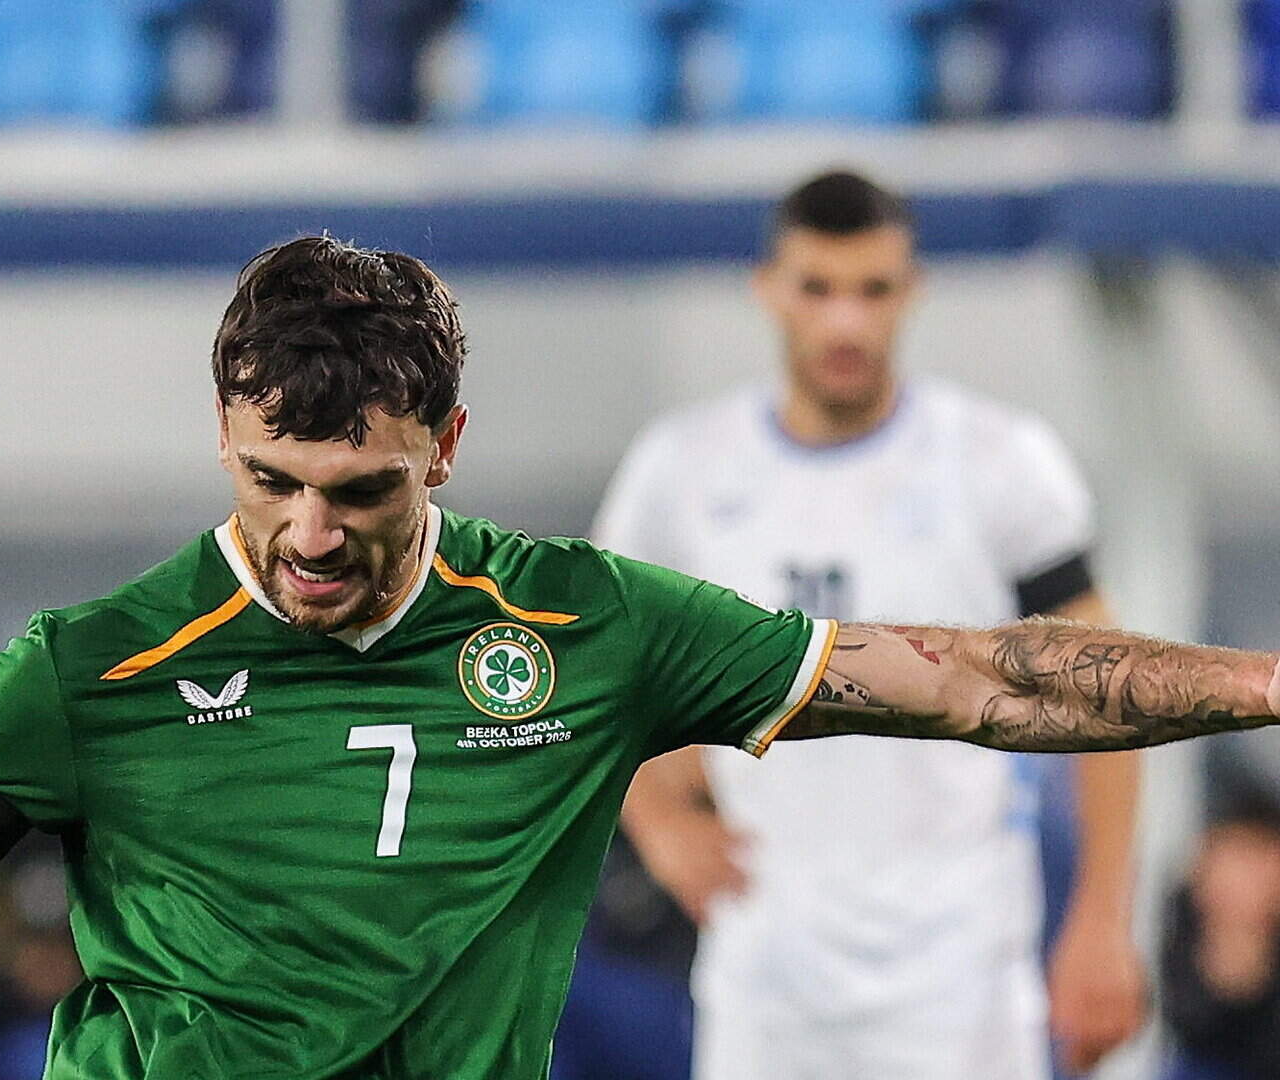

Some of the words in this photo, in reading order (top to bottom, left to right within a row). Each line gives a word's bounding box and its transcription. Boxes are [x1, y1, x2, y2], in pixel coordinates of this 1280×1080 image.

[464, 628, 541, 665] IRELAND
[485, 694, 542, 714] FOOTBALL
[511, 719, 565, 738] TOPOLA
[456, 739, 477, 748] 4th
[479, 734, 543, 748] OCTOBER
[346, 724, 417, 857] 7
